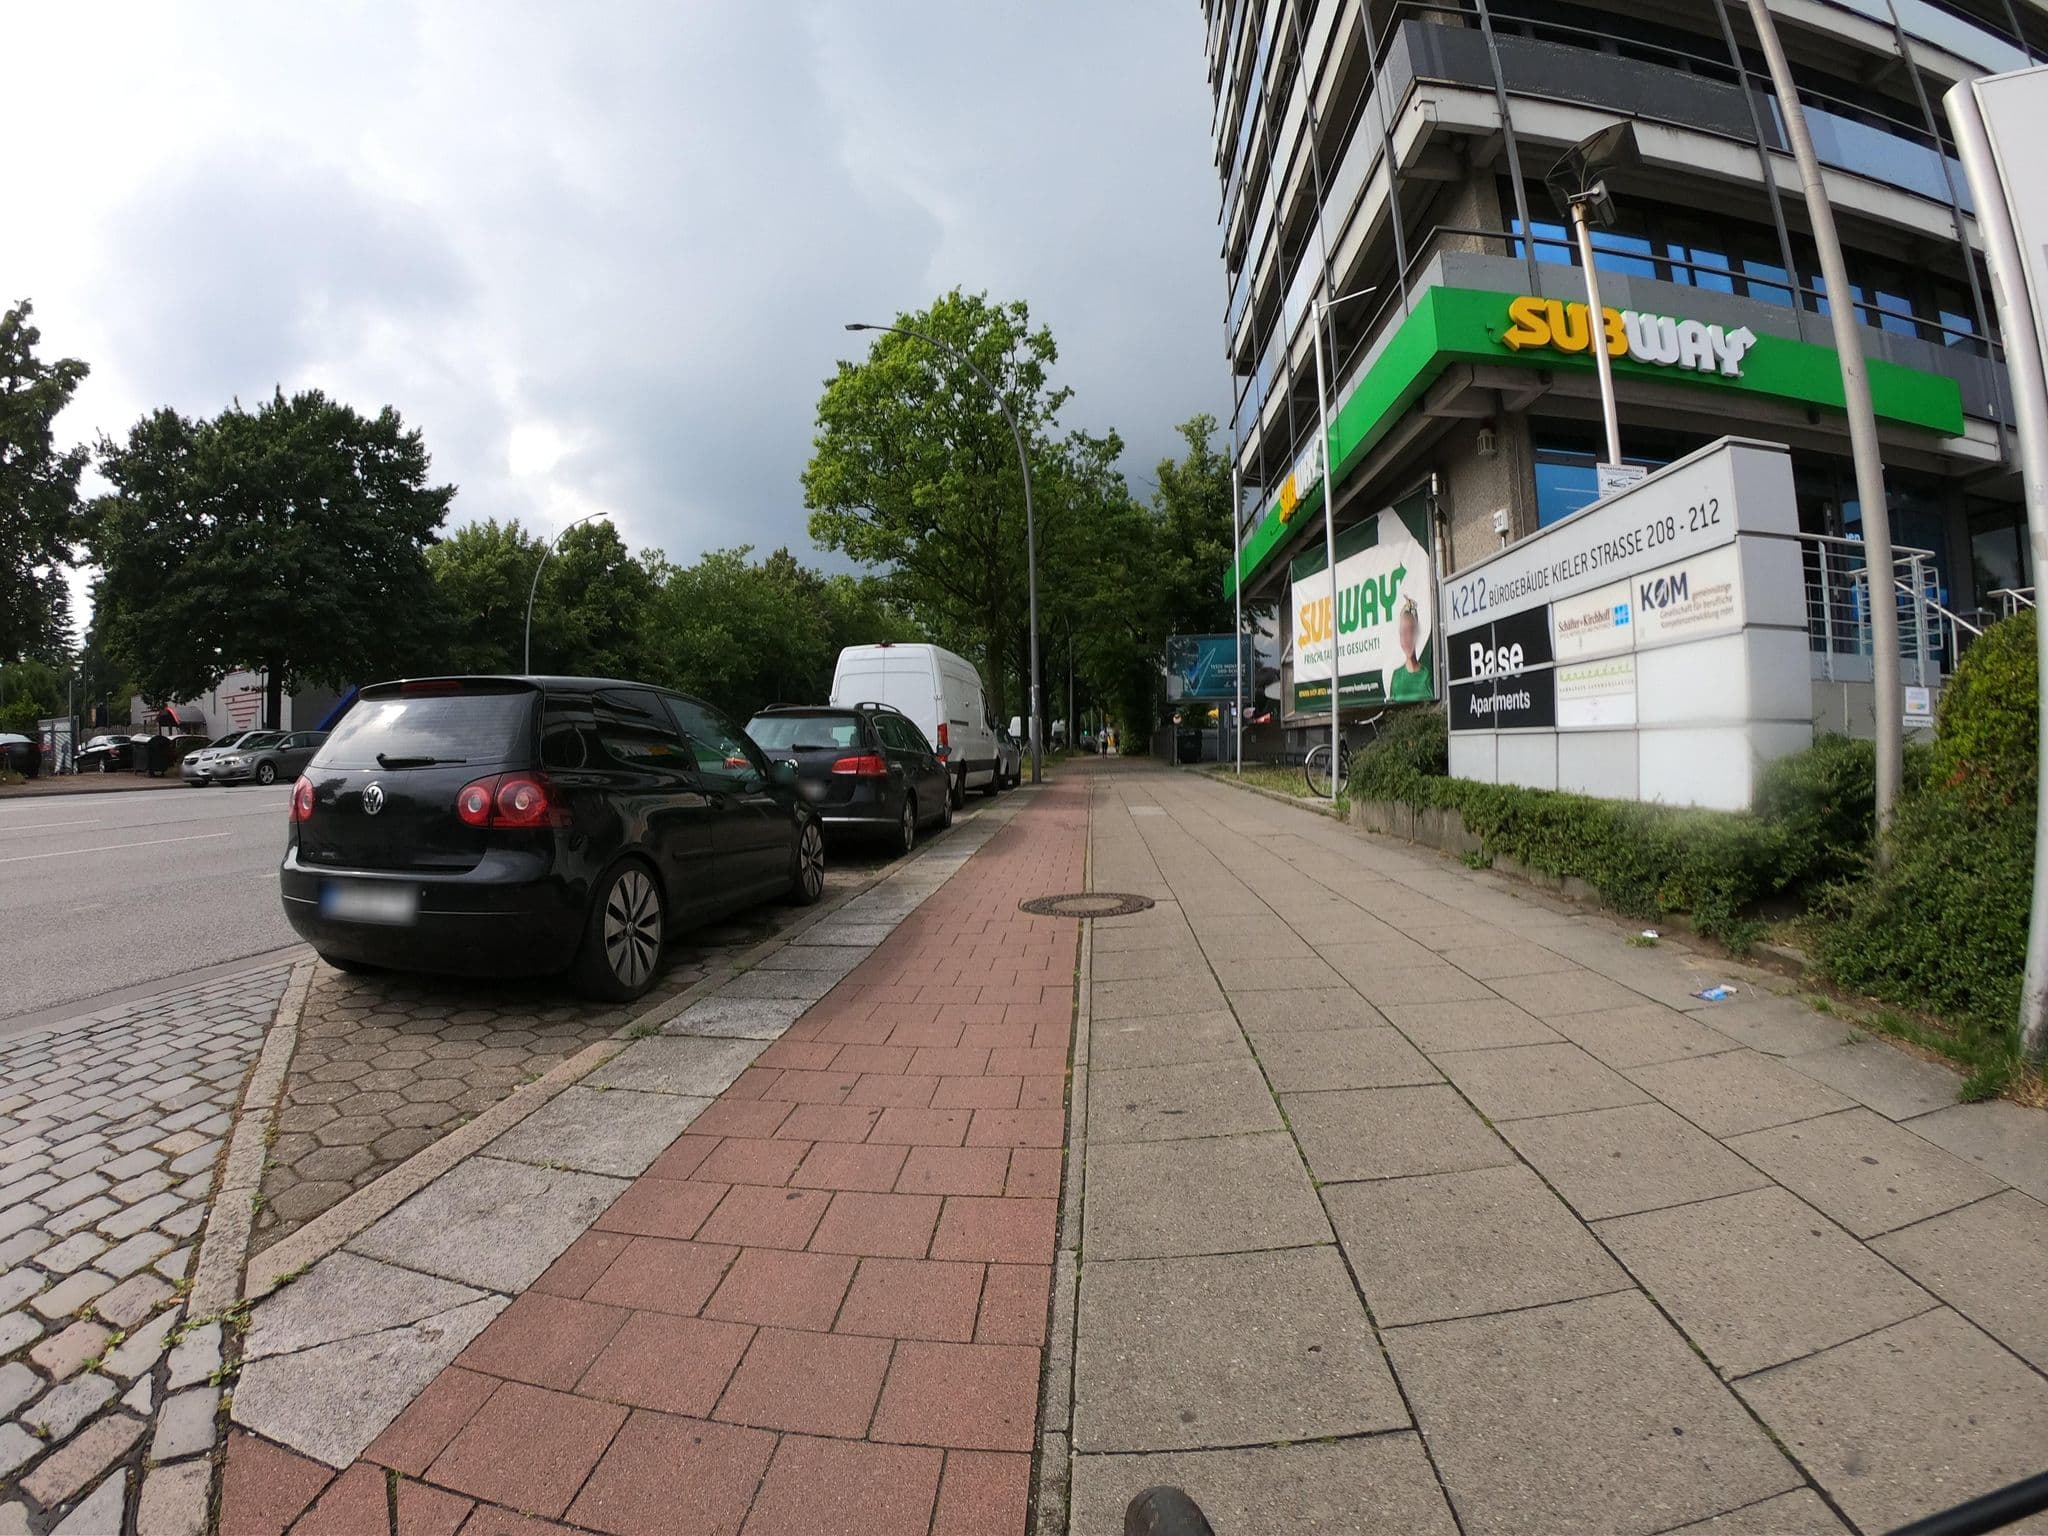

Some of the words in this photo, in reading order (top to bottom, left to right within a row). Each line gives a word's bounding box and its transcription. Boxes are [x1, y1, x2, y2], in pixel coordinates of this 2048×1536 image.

[1503, 296, 1757, 377] SUBWAY
[1489, 567, 1549, 607] BÜROGEBÄUDE
[1551, 551, 1589, 582] KIELER
[1591, 529, 1643, 569] STRASSE
[1647, 516, 1676, 548] 208
[1689, 498, 1720, 532] 212
[1347, 637, 1381, 655] GESUCHT!
[1470, 642, 1524, 685] Base
[1470, 689, 1531, 718] Apartments
